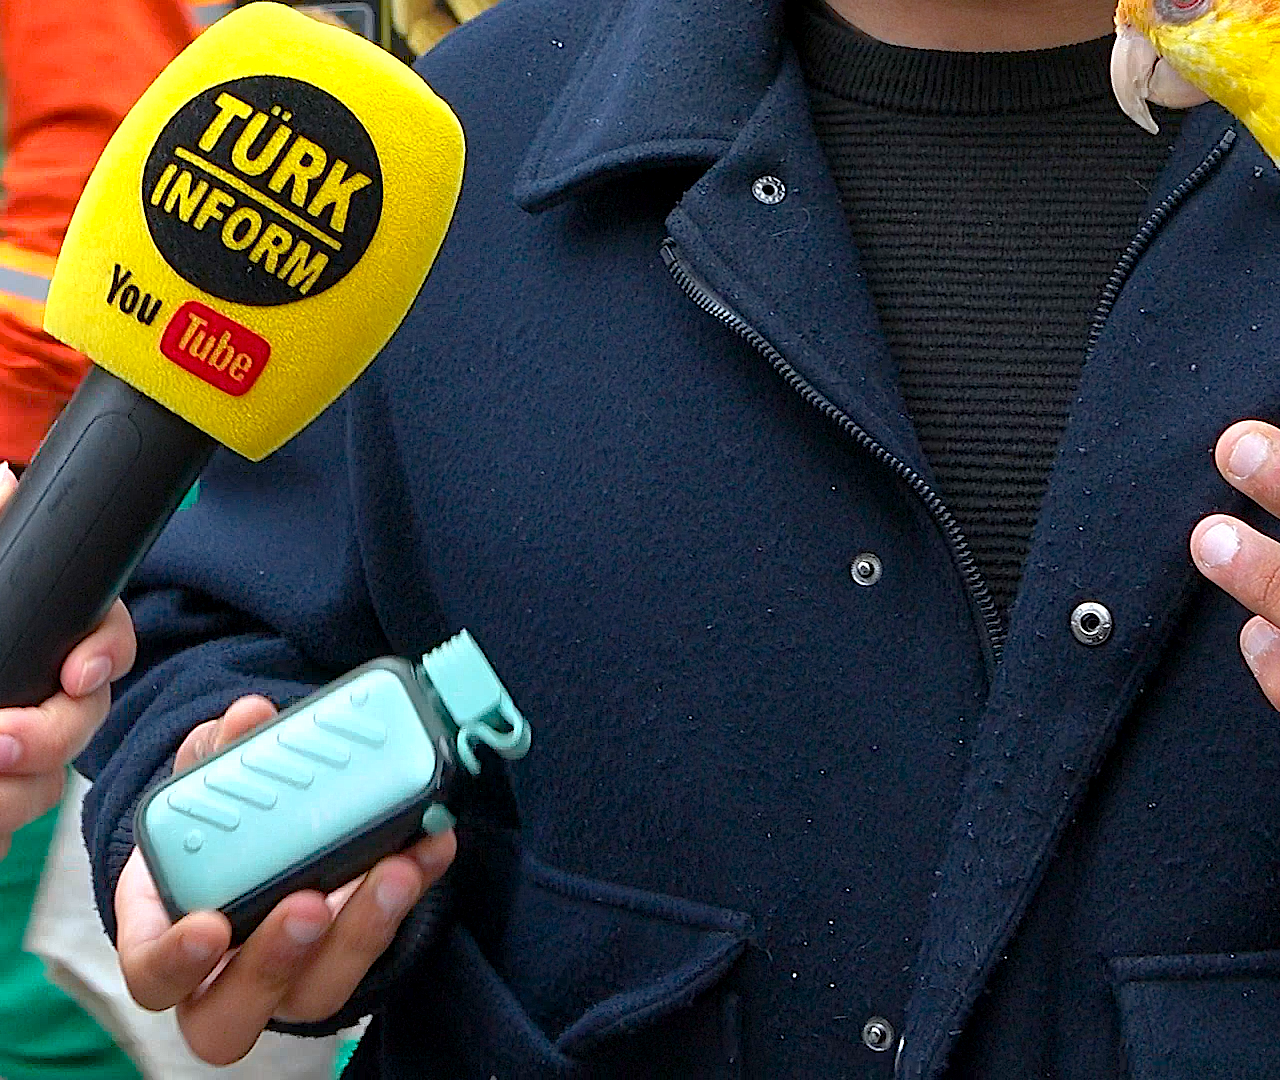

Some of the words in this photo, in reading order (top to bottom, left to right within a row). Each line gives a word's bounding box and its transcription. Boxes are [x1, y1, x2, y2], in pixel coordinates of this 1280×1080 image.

[197, 91, 373, 234] TÜRK
[150, 163, 330, 296] INFORM
[106, 263, 164, 327] You
[176, 311, 254, 382] Tube
